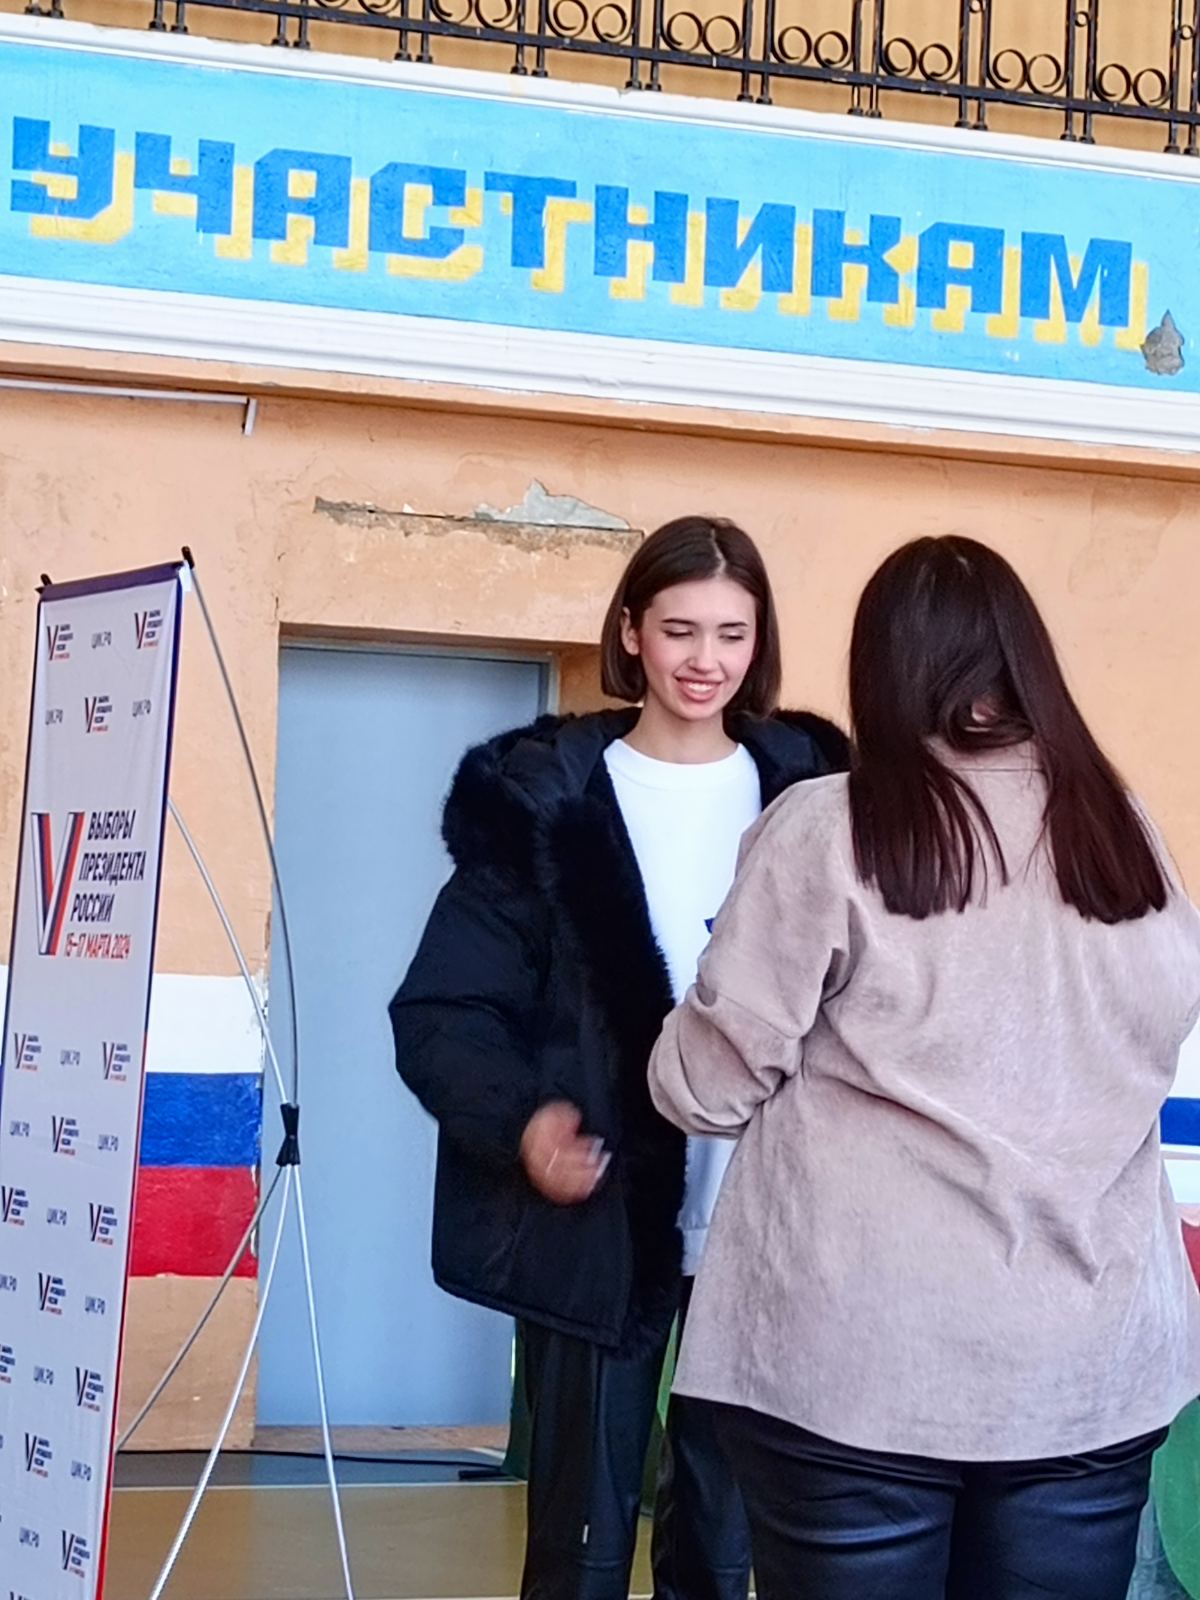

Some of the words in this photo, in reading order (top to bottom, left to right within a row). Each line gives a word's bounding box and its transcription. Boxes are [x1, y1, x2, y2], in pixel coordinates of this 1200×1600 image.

[11, 114, 1147, 349] УЧАСТНИКАМ
[87, 809, 136, 840] ВЫБОРЫ
[78, 851, 147, 886] ПРЕЗИДЕНТА
[70, 893, 115, 922] РОССИИ
[85, 933, 112, 958] МАРТА
